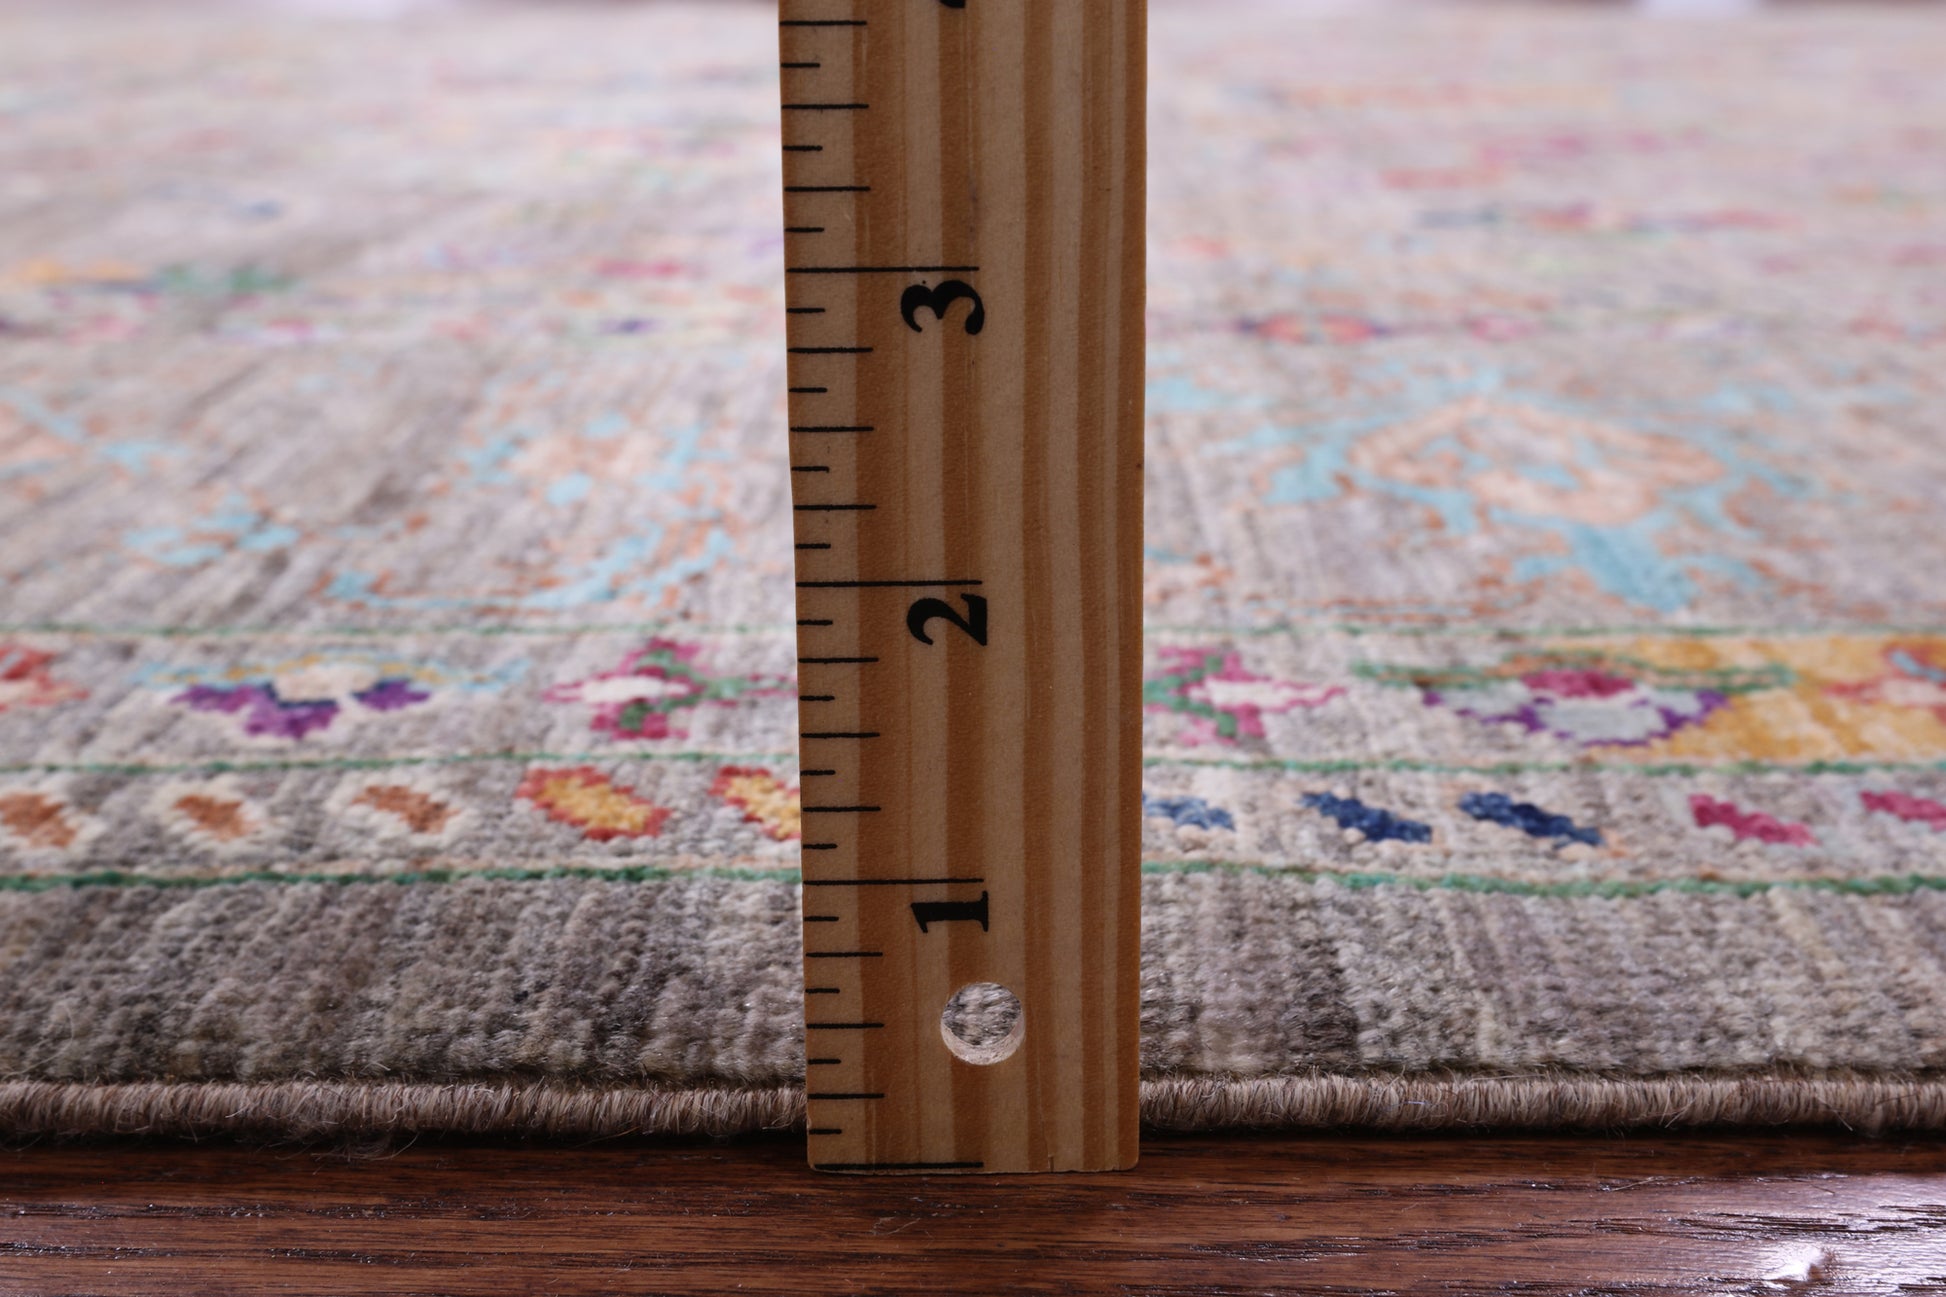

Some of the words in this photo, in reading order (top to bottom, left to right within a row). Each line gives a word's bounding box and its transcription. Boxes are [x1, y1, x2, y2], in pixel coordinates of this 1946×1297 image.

[900, 279, 985, 336] 3
[906, 592, 988, 647] 2
[910, 890, 990, 934] 1
